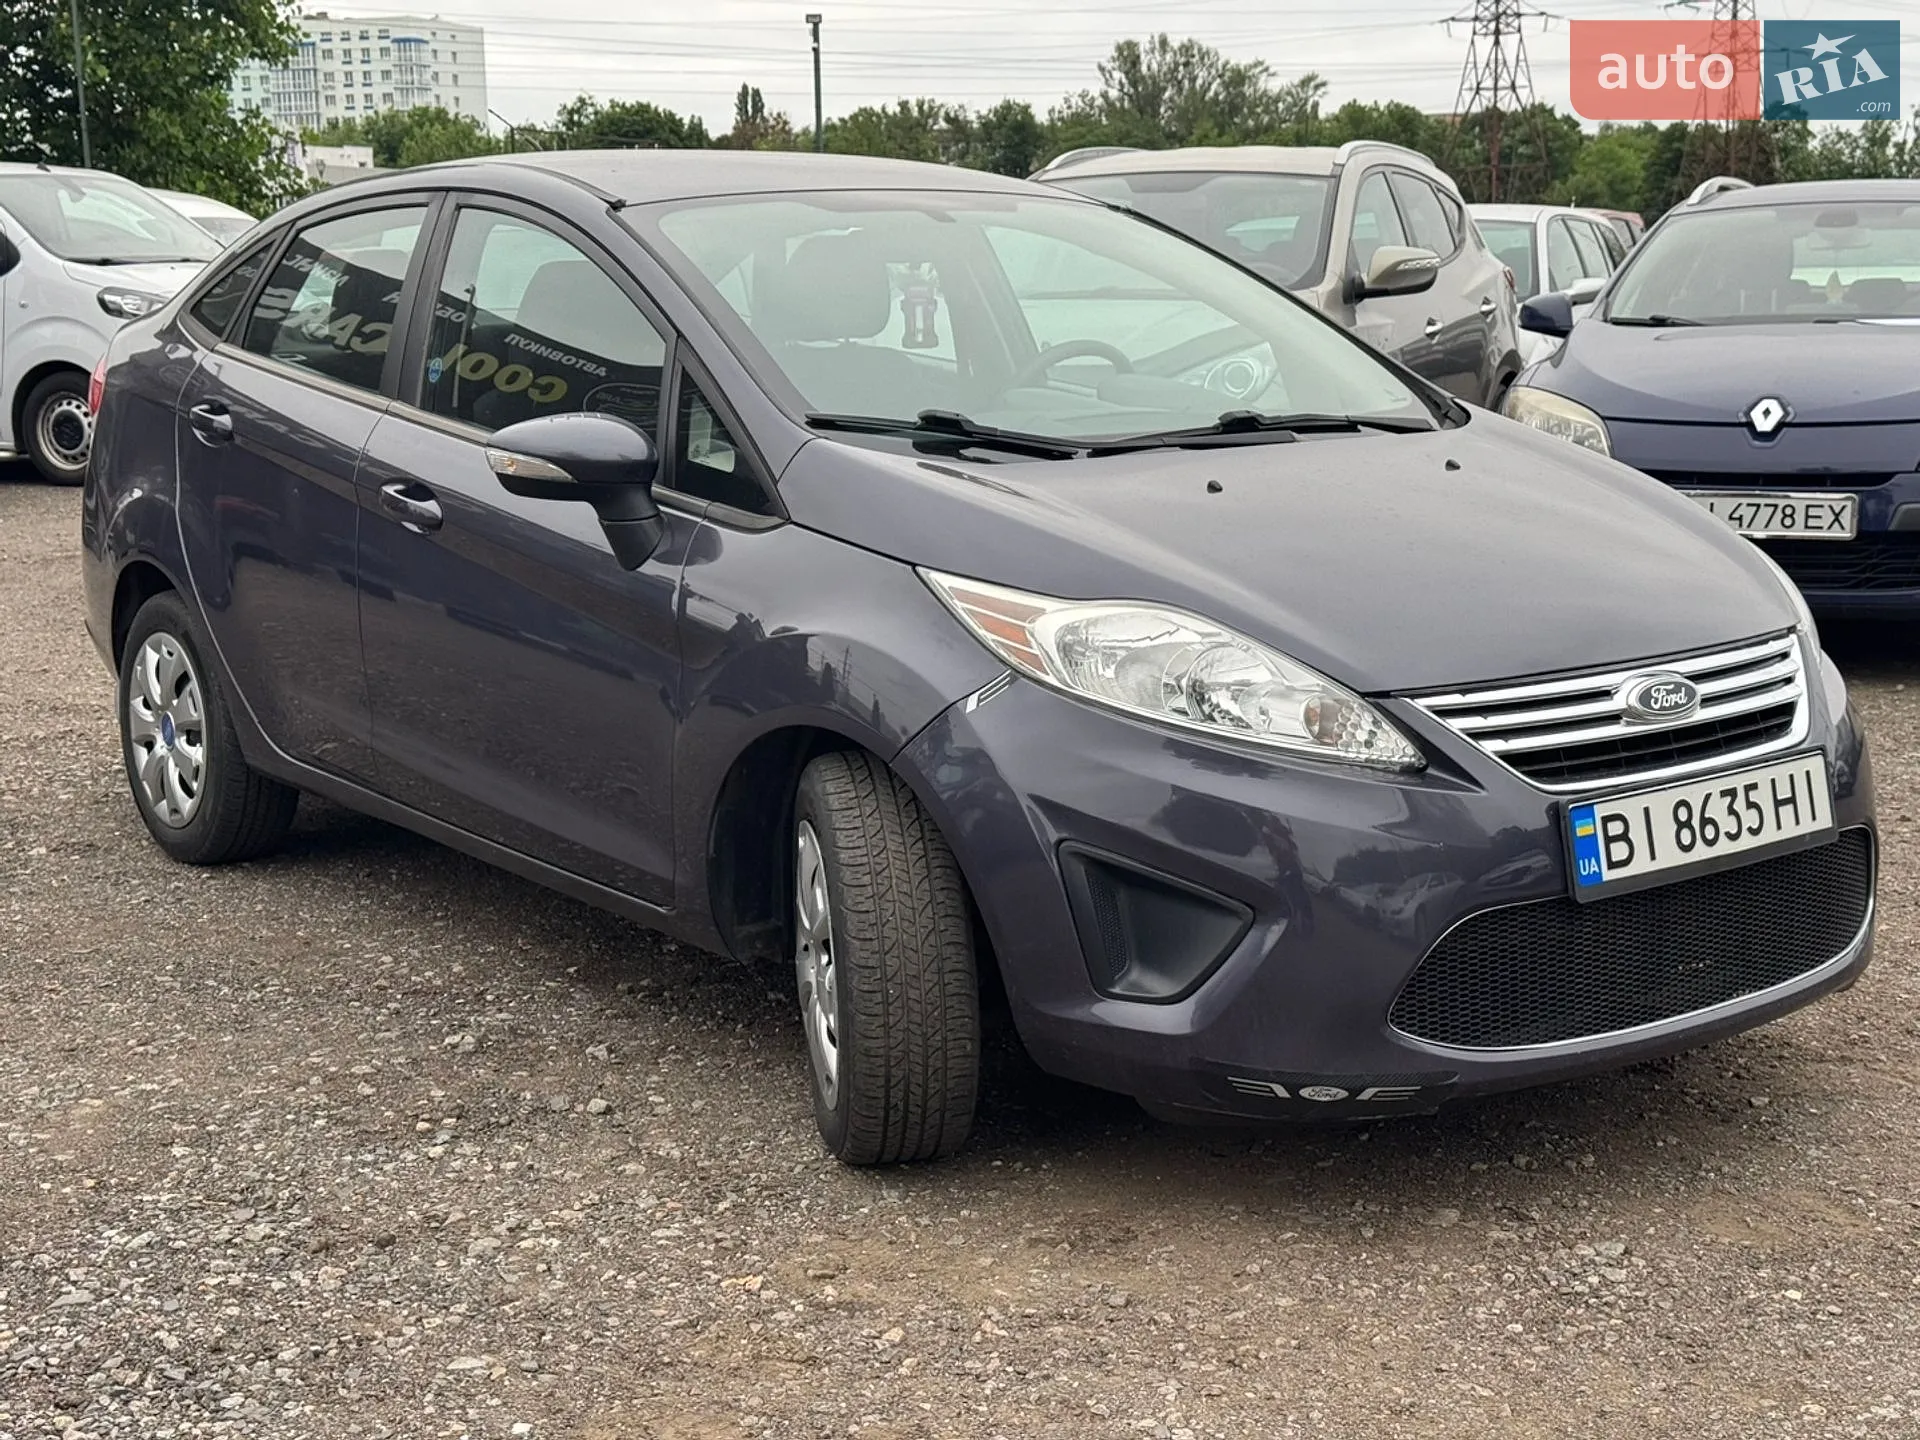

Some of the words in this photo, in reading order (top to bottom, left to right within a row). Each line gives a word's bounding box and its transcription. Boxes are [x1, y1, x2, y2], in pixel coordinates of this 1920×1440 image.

[1728, 502, 1796, 529] 4778
[1804, 503, 1848, 530] EX
[1650, 683, 1688, 710] Ford
[1600, 806, 1656, 871] BI
[1672, 783, 1764, 853] 8635
[1769, 769, 1817, 831] HI
[1579, 858, 1600, 877] UA
[1308, 1087, 1341, 1099] Ford
